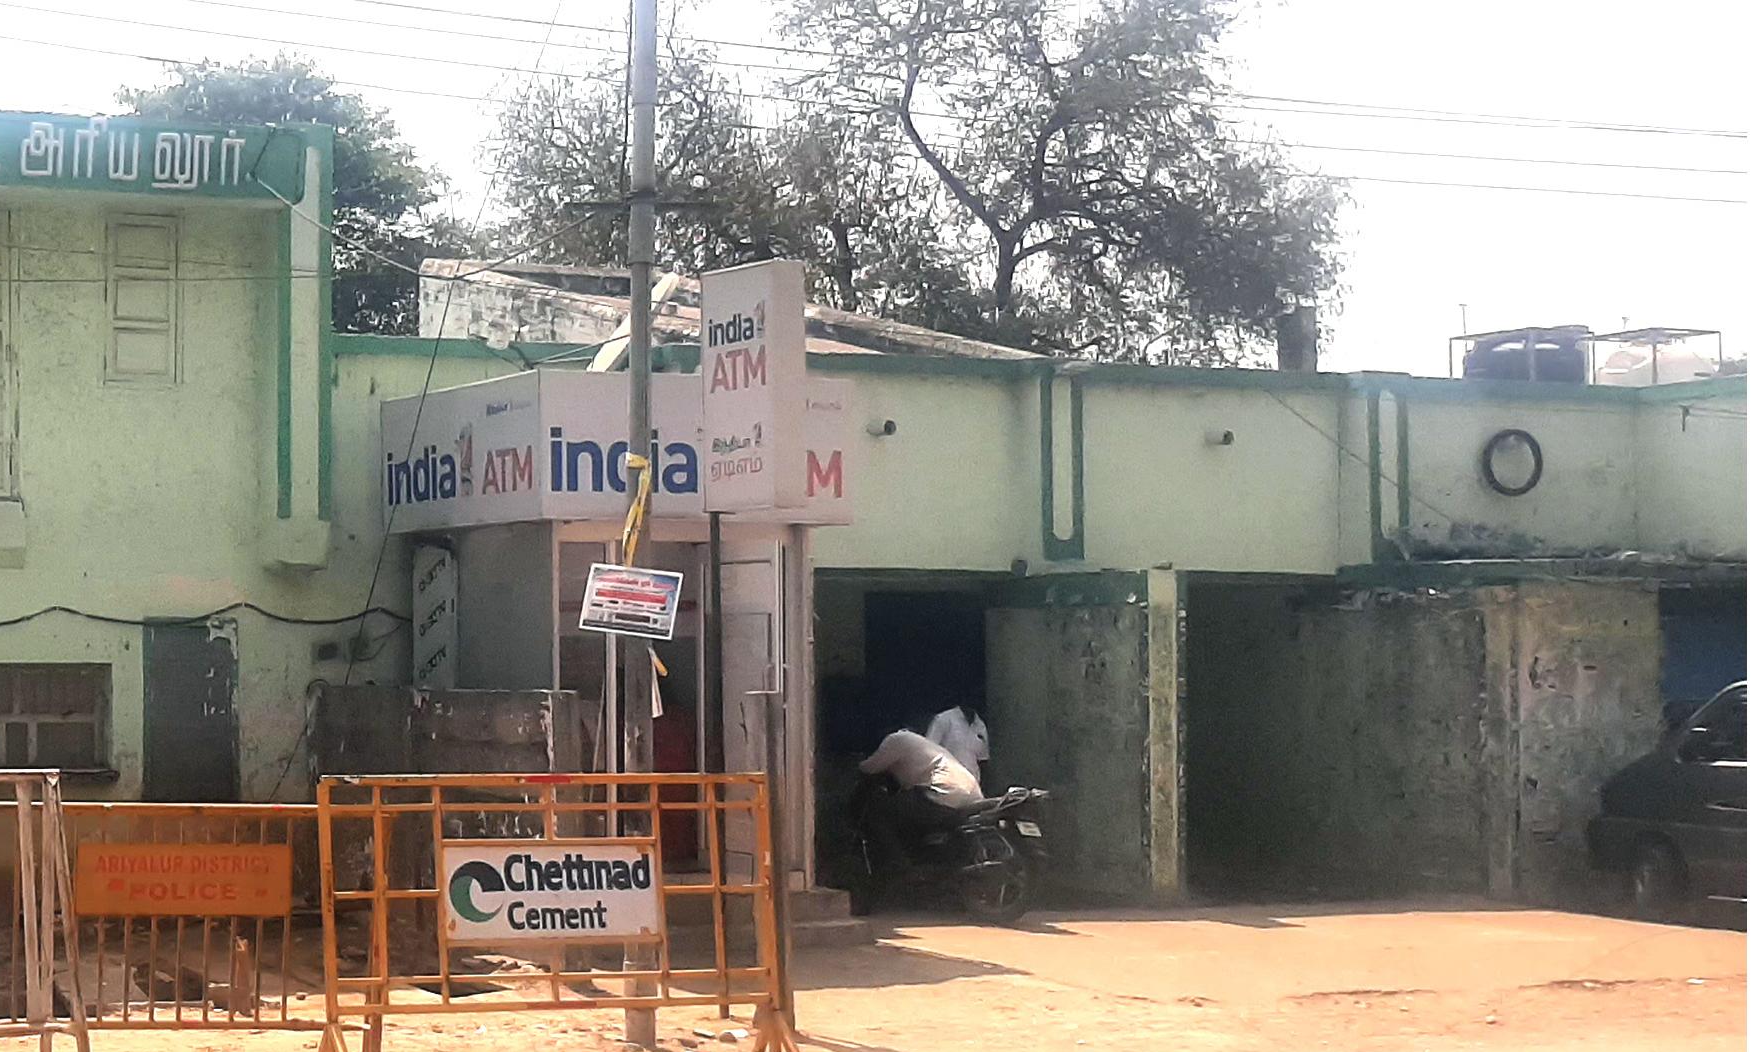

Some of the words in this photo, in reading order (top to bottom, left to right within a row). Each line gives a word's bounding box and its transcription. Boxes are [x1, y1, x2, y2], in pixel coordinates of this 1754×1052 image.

[20, 115, 246, 190] அரியலூர்
[710, 344, 766, 394] ATM
[387, 445, 457, 506] india
[482, 445, 533, 495] ATM
[96, 854, 185, 873] ARIYALUR
[190, 854, 272, 874] DISTRICT
[504, 854, 651, 892] Chettinad
[129, 881, 239, 901] POLICE
[507, 901, 607, 930] Cement
